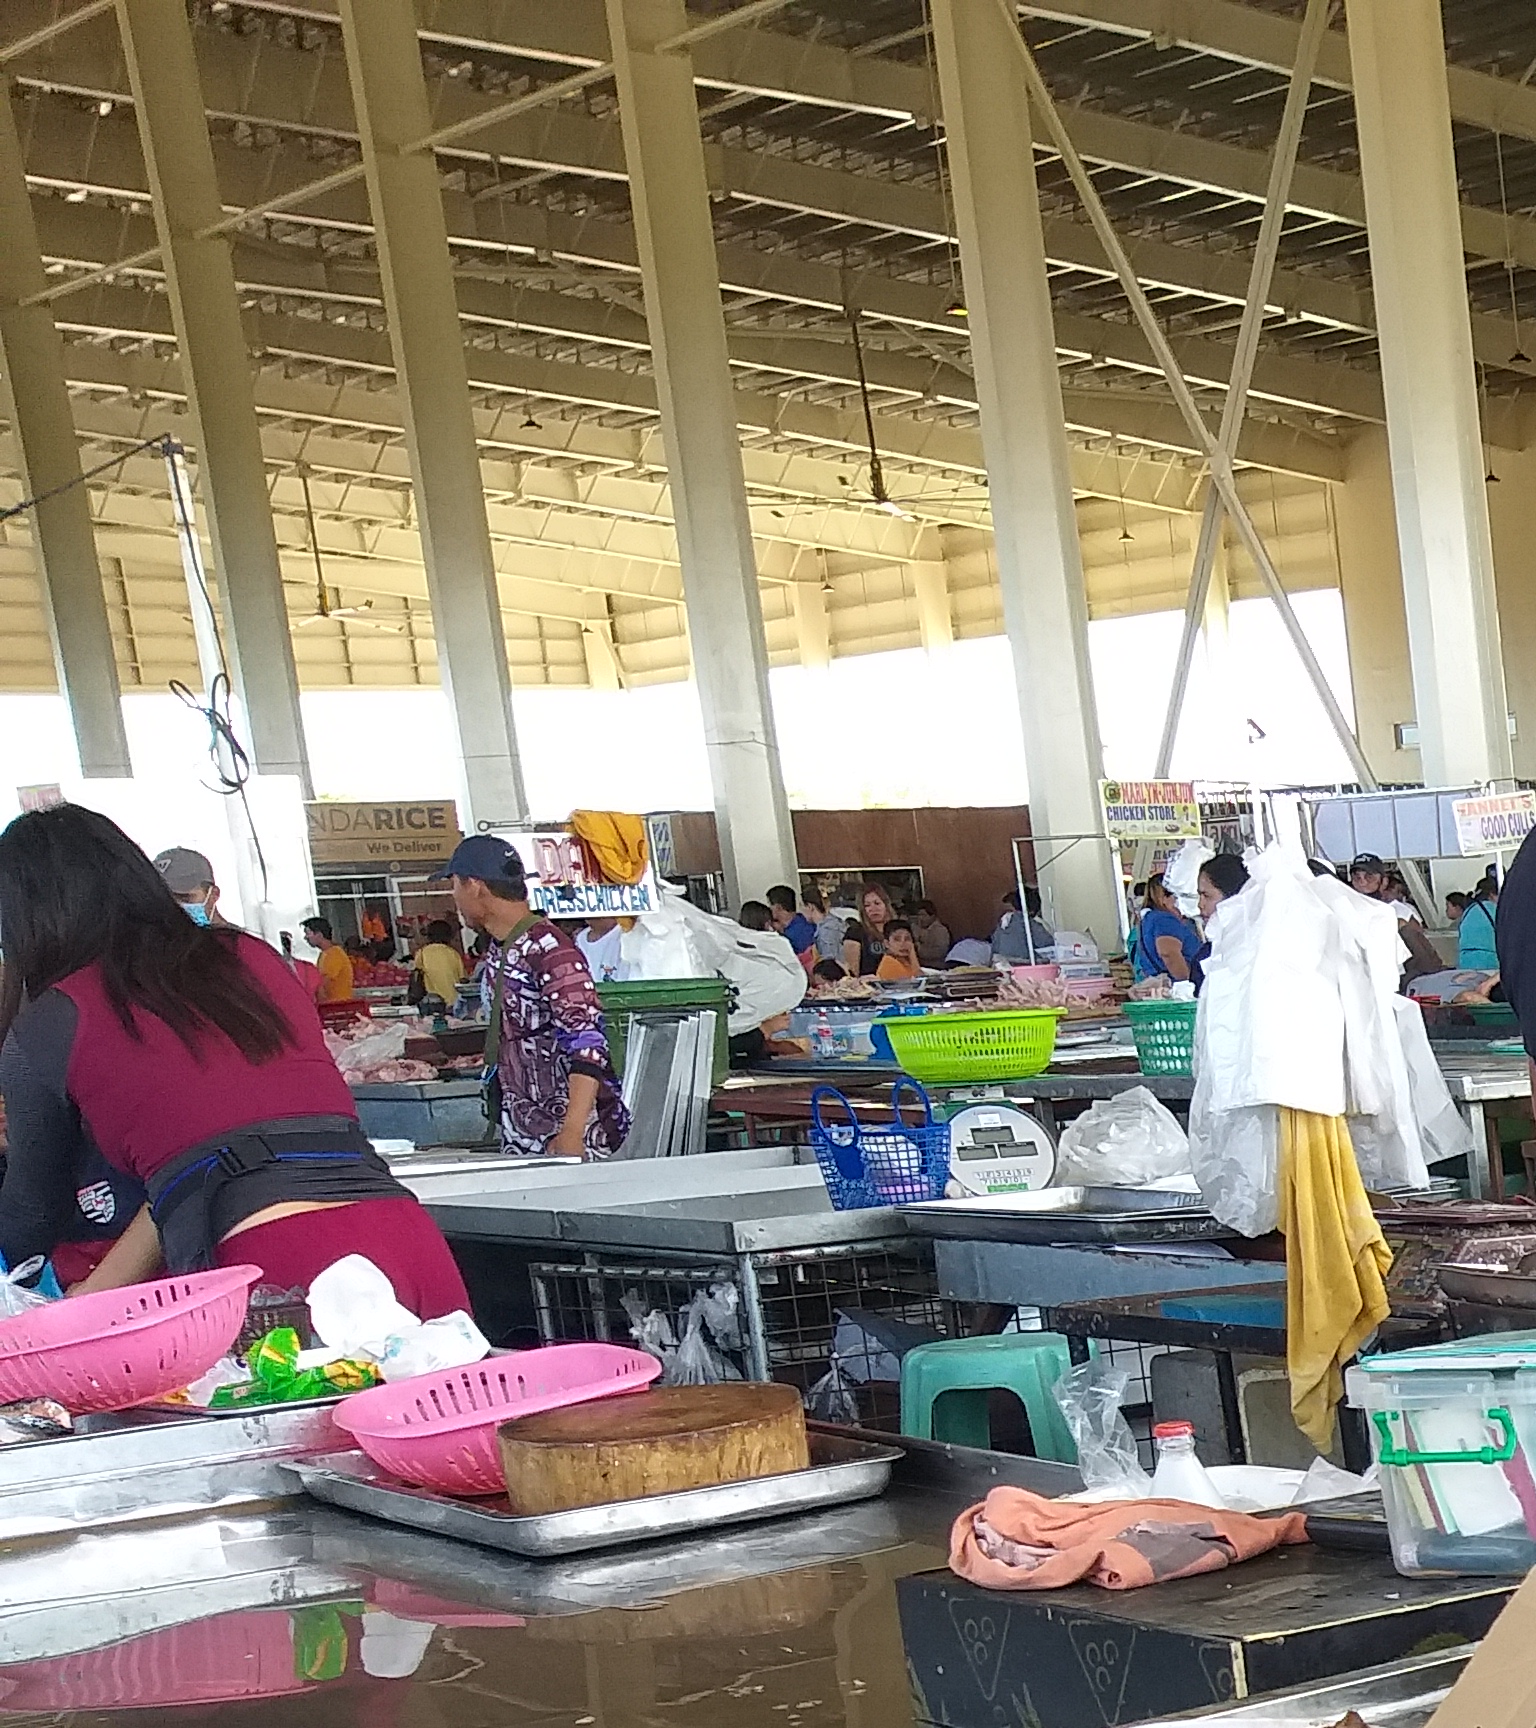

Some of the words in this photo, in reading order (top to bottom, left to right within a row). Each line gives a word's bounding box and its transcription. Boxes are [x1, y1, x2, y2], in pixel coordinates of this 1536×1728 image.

[1106, 805, 1147, 822] CHICKEN
[1148, 805, 1177, 821] STORE
[1481, 813, 1507, 841] GOOD
[366, 842, 390, 854] We
[393, 841, 442, 854] Deliver
